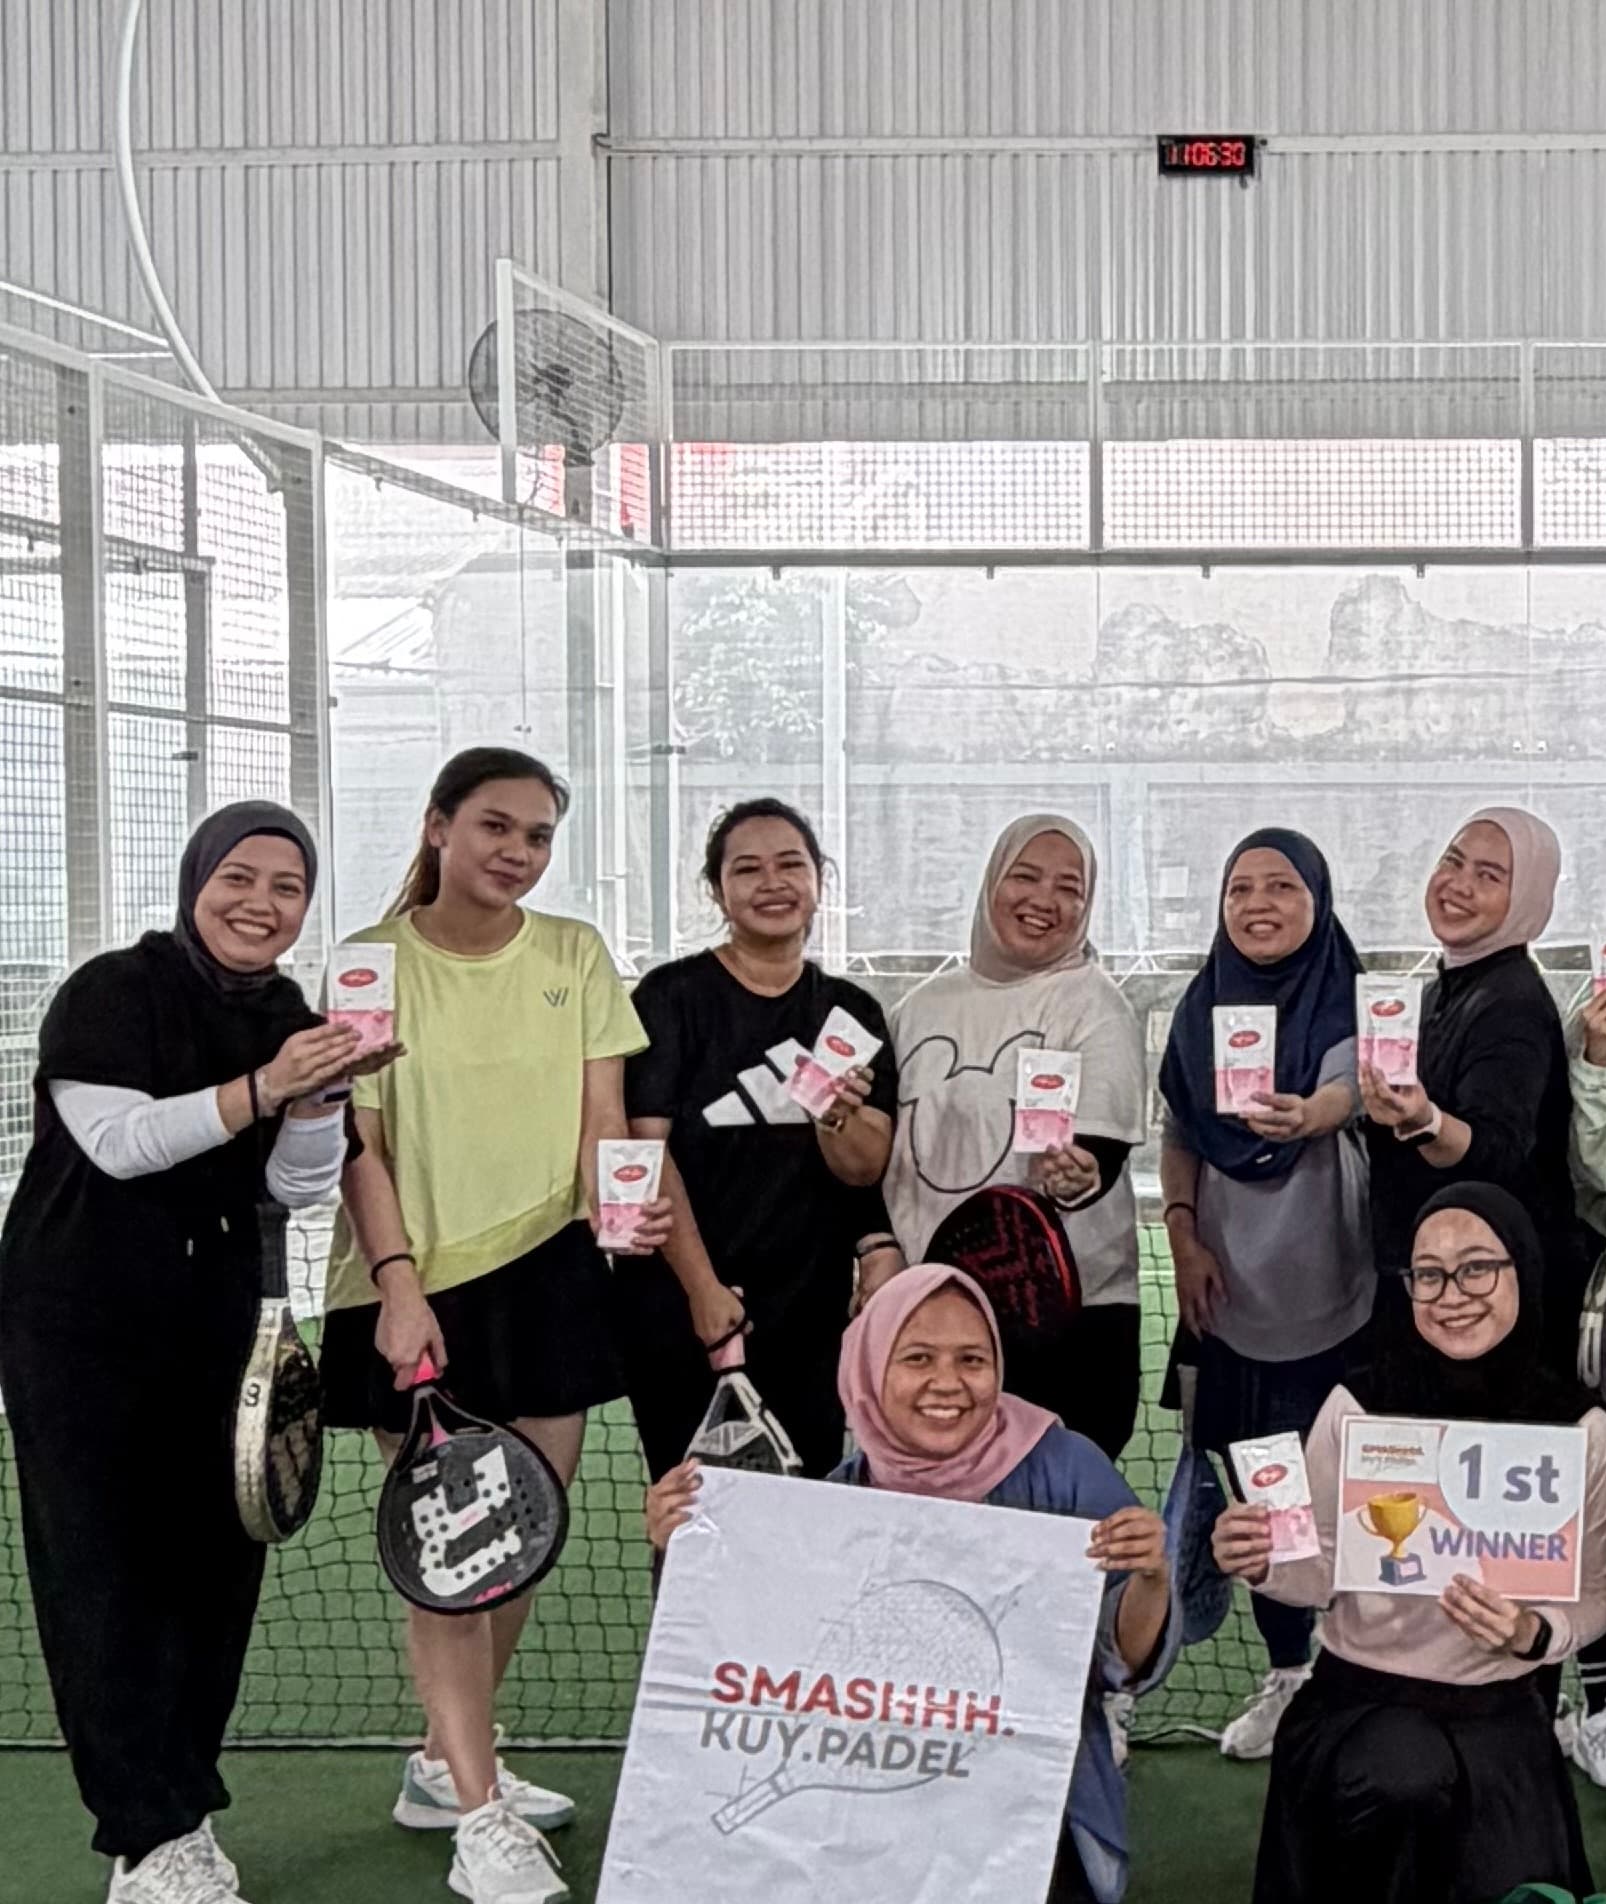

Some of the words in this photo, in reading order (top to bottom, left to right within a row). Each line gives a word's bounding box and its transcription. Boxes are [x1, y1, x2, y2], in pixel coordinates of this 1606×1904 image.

[1459, 1443, 1482, 1499] 1
[1502, 1455, 1560, 1504] st
[1428, 1526, 1569, 1561] WINNER
[710, 1661, 1015, 1737] SMASHHH.
[700, 1710, 970, 1779] KUY.PADEL
